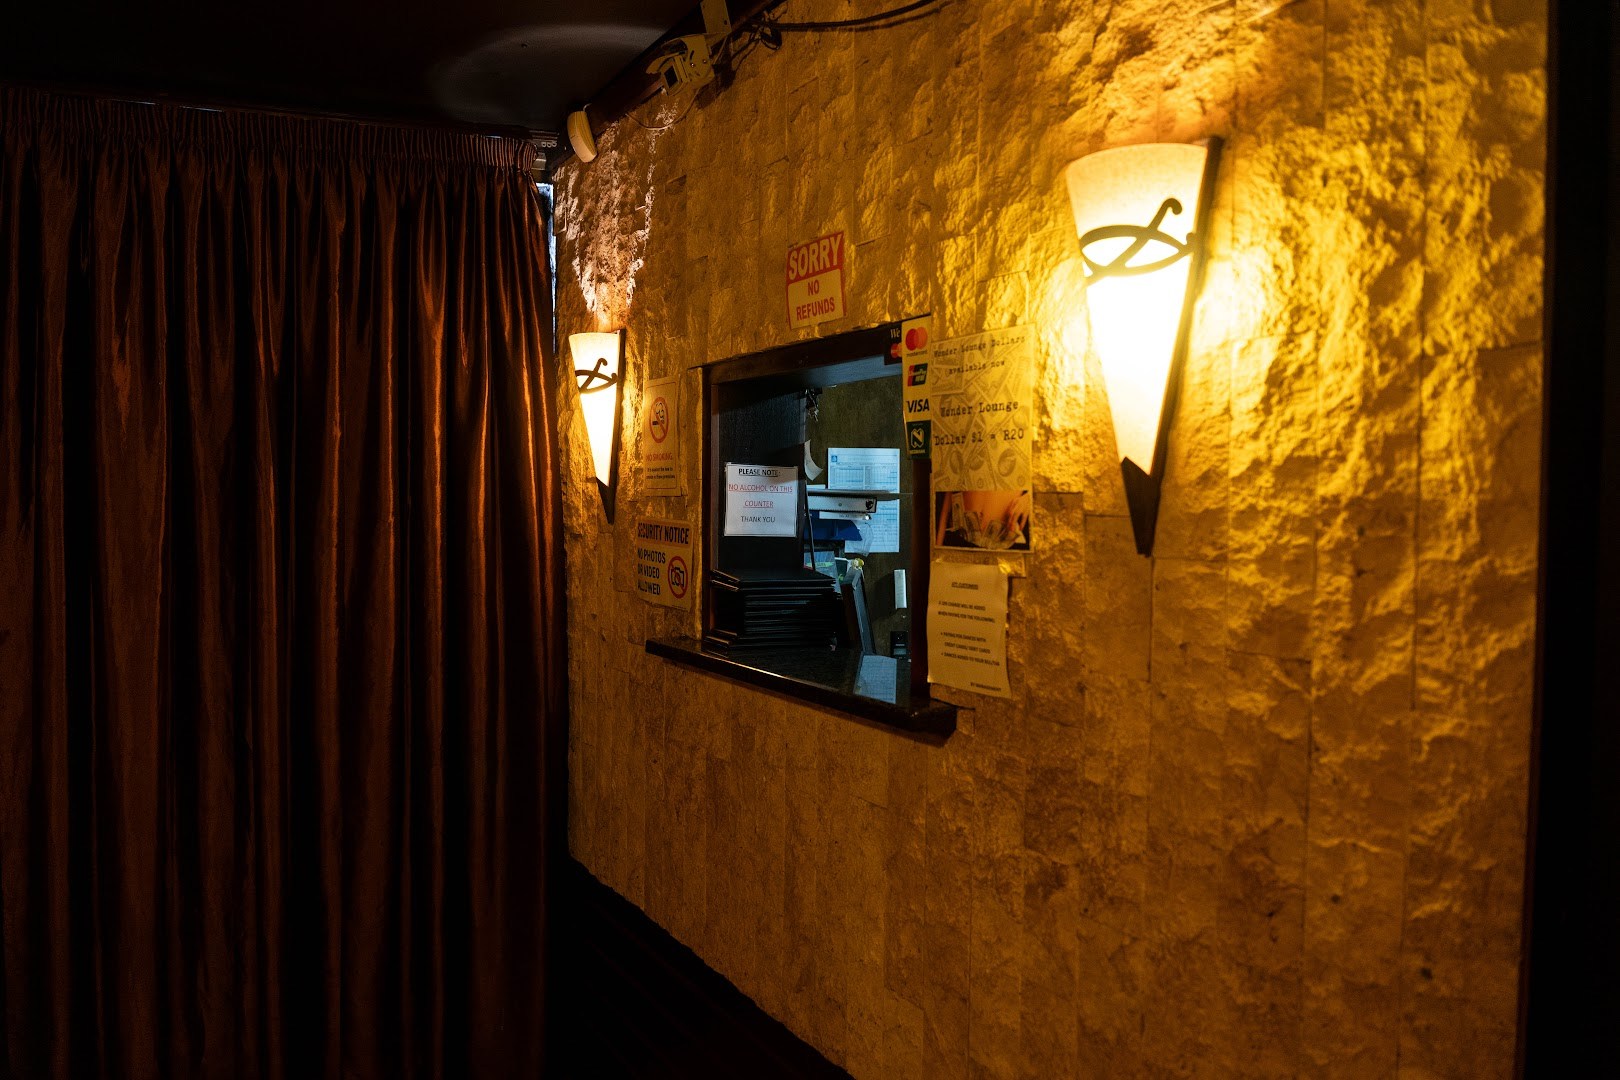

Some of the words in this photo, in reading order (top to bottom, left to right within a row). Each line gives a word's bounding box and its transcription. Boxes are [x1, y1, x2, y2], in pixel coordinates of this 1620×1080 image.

[788, 234, 842, 280] SORRY
[807, 280, 820, 296] NO
[796, 297, 835, 321] REFUNDS
[934, 348, 957, 358] Wonder
[961, 343, 986, 353] Lounge
[991, 336, 1025, 347] Dollars
[949, 363, 986, 375] available
[990, 360, 1005, 368] now
[907, 399, 930, 413] VISA
[940, 405, 973, 418] Wonder
[979, 401, 1019, 413] Lounge
[934, 434, 966, 446] Dollar
[971, 431, 983, 443] $1
[1003, 428, 1024, 441] R20
[738, 468, 761, 476] PLEASE
[728, 484, 739, 492] NO
[740, 484, 768, 492] ALCOHOL
[769, 485, 779, 493] ON
[744, 500, 774, 508] COUNTER
[741, 515, 762, 523] THANK
[664, 525, 690, 545] NOTICE
[643, 548, 666, 565] PHOTOS
[643, 565, 660, 580] VIDEO
